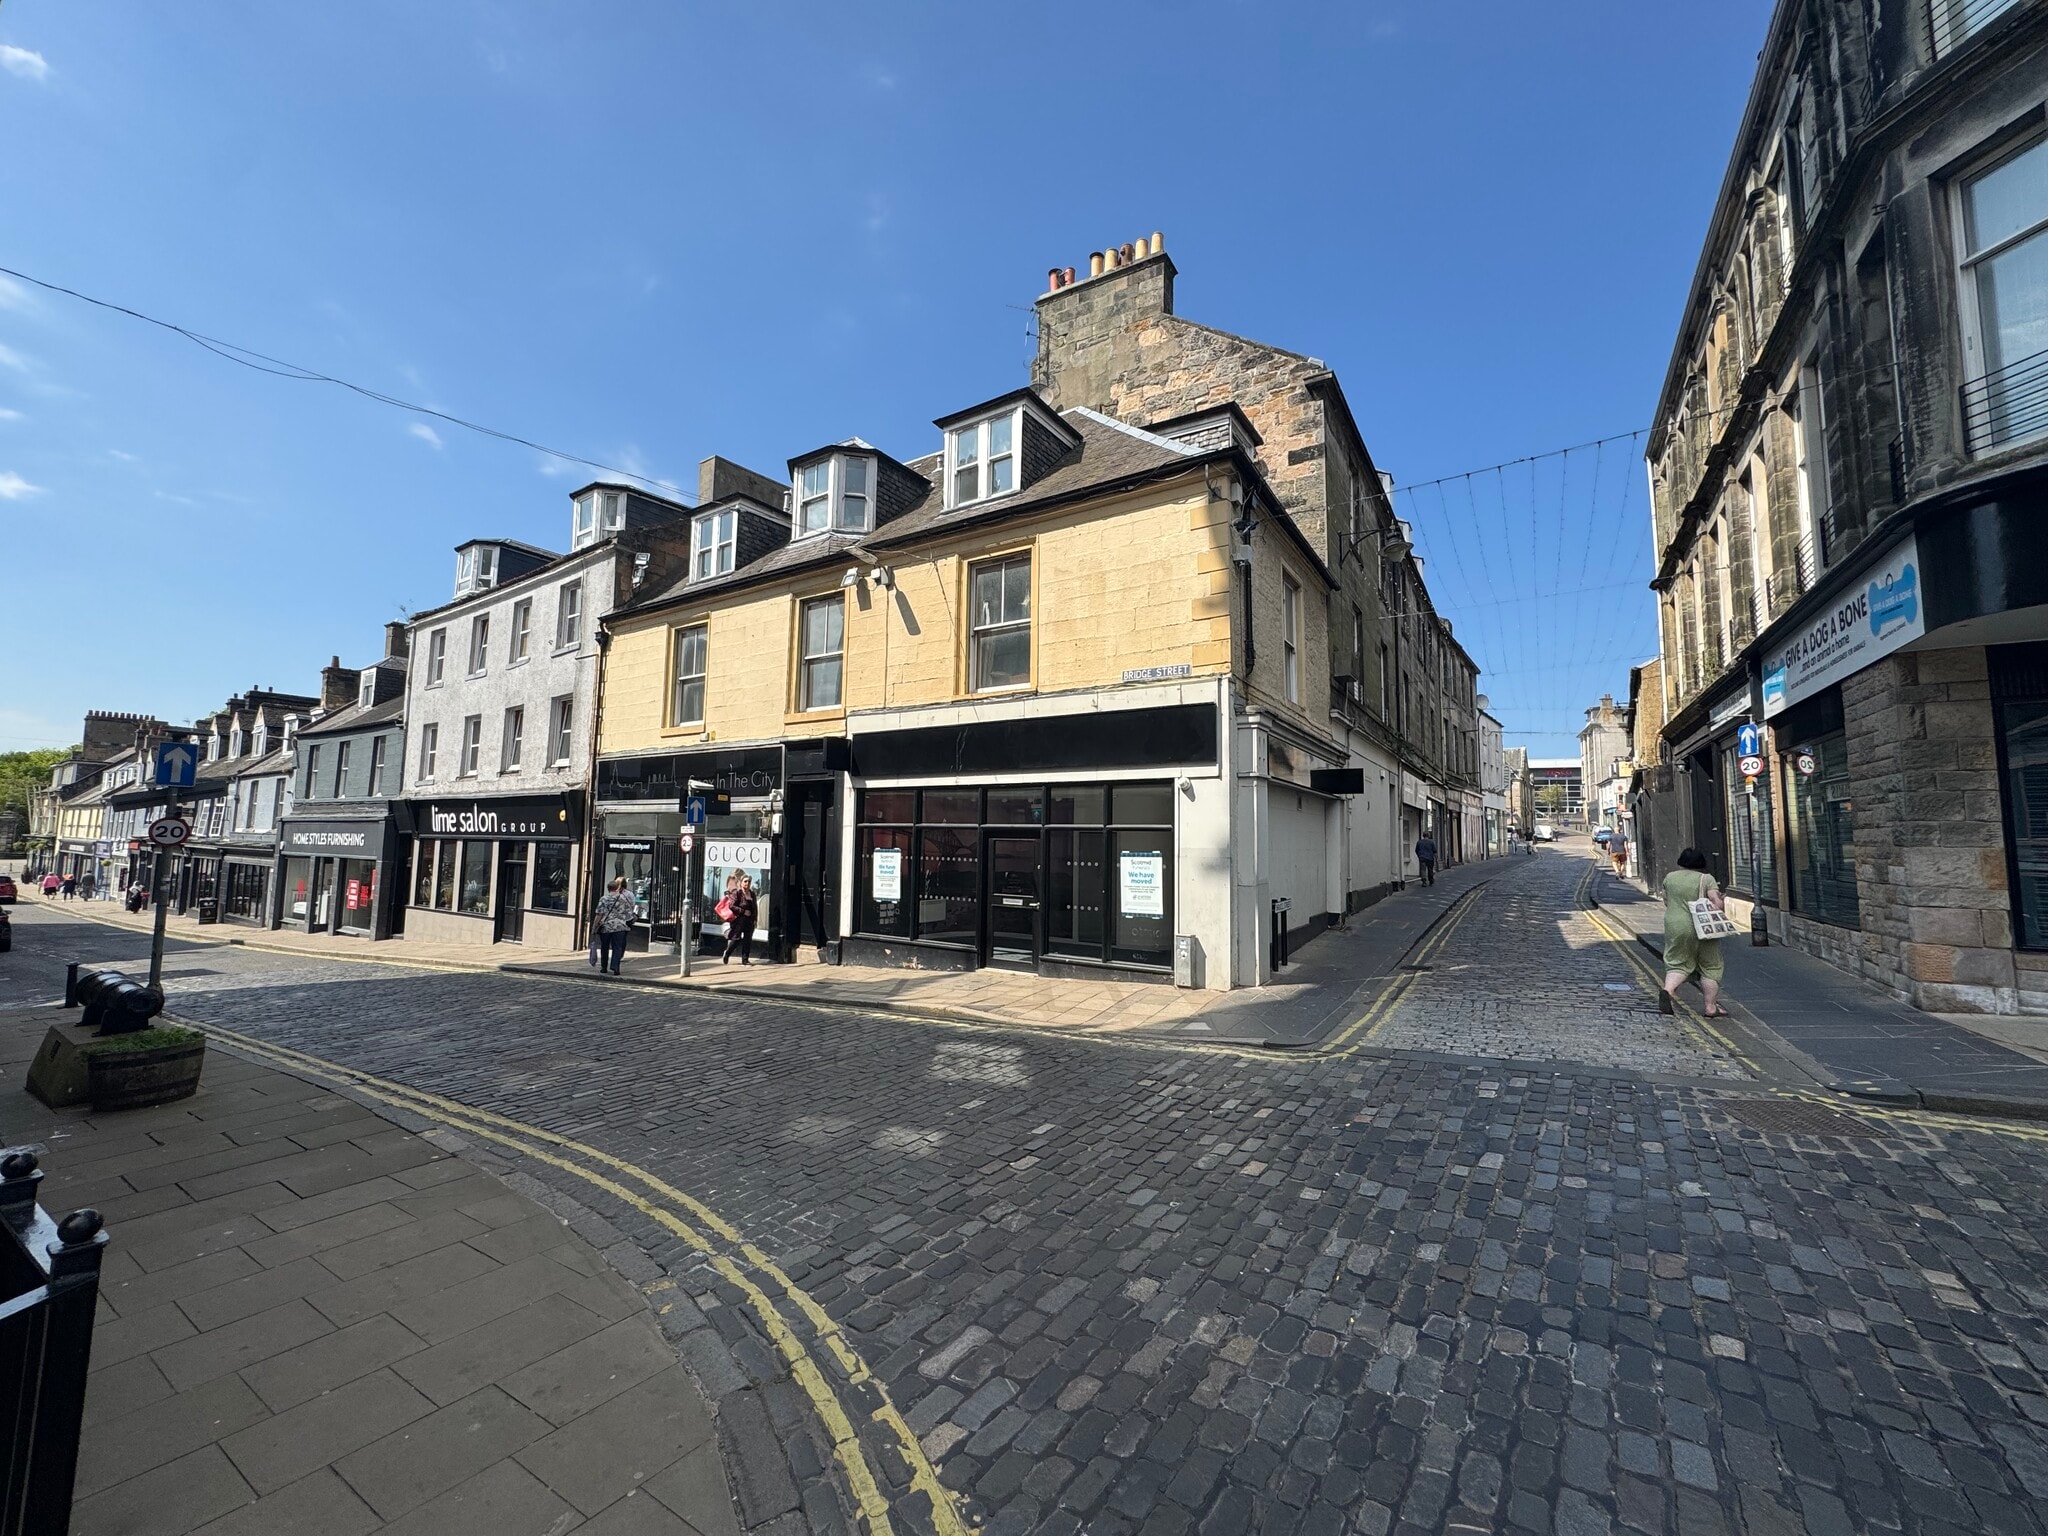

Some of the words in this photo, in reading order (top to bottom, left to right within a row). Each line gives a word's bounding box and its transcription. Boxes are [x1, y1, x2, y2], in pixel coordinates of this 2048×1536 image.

[1785, 642, 1801, 669] GIVE
[1802, 638, 1808, 658] A
[1809, 622, 1829, 653] DOG
[1830, 617, 1838, 640] A
[1839, 593, 1868, 632] BONE
[1811, 656, 1817, 667] an
[1817, 642, 1832, 663] animal
[1832, 643, 1836, 653] a
[1835, 634, 1850, 651] home
[1123, 669, 1152, 680] BRIDGE
[1156, 665, 1189, 677] STREET
[1742, 760, 1760, 771] 20
[716, 773, 726, 790] In
[728, 771, 748, 789] The
[751, 770, 775, 792] City
[431, 804, 457, 832] lime
[459, 802, 498, 832] salon
[500, 822, 546, 833] GROUP
[155, 825, 184, 838] 20
[293, 833, 309, 845] HOME
[309, 833, 327, 846] STYLES
[327, 833, 365, 847] FURNISHING
[708, 845, 768, 864] GUCCI
